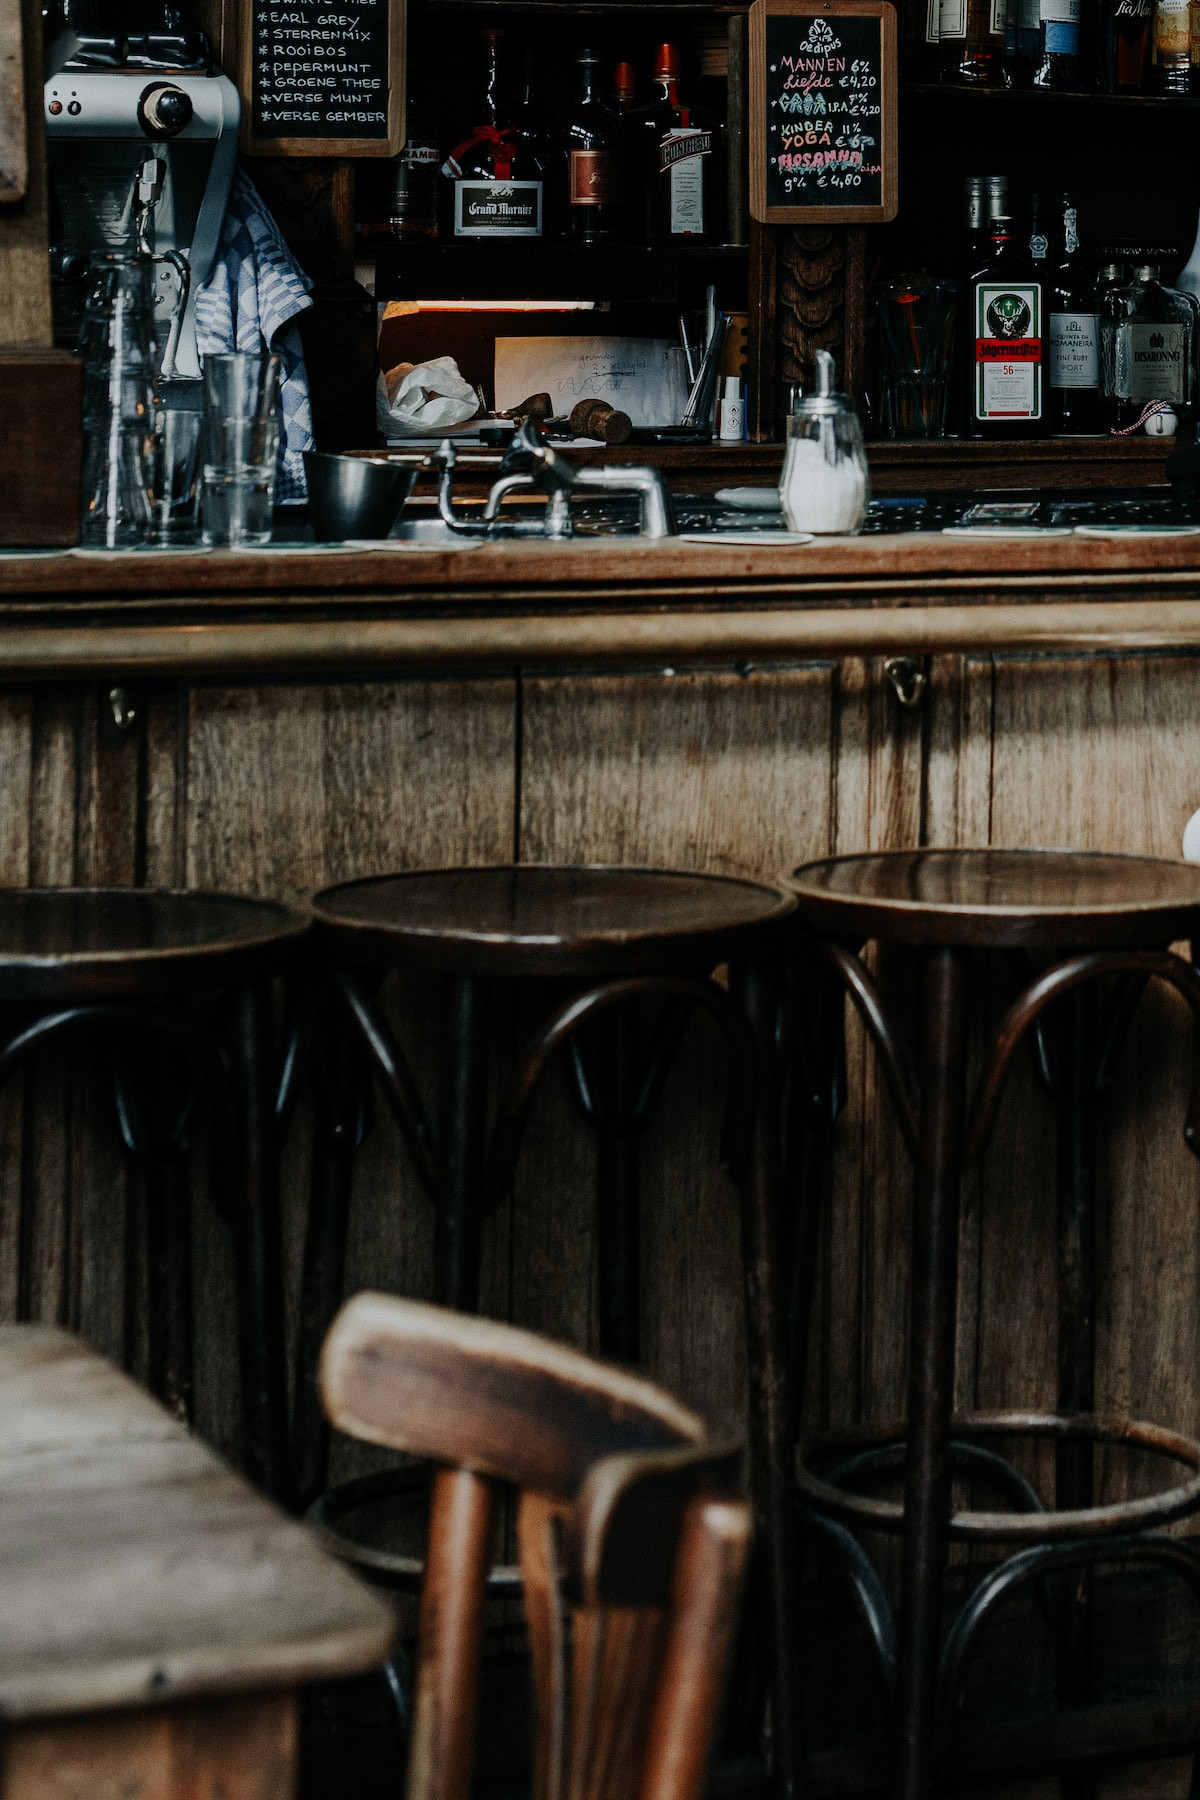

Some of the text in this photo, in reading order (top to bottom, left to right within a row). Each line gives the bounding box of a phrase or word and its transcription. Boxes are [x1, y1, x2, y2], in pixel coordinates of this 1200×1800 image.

[270, 11, 360, 31] EARL GREY
[800, 37, 842, 58] Oedipus
[780, 56, 870, 72] MANNEN 6%
[275, 77, 382, 89] GROENE THEE
[783, 71, 876, 95] Liefde €4,20
[272, 93, 373, 103] VERSE MUNT
[273, 111, 386, 122] VERSE GEMBER
[849, 105, 881, 116] €4,20
[780, 120, 834, 136] KINDER
[781, 131, 831, 151] YOGA
[779, 150, 862, 174] HOSANNA
[785, 176, 807, 192] 9%
[831, 174, 862, 188] 4,80
[469, 202, 533, 215] Grand Marnier
[979, 343, 1040, 358] Jägermeister
[1134, 351, 1180, 362] DISARONNO
[1003, 366, 1014, 375] 56
[1061, 364, 1083, 372] PORT
